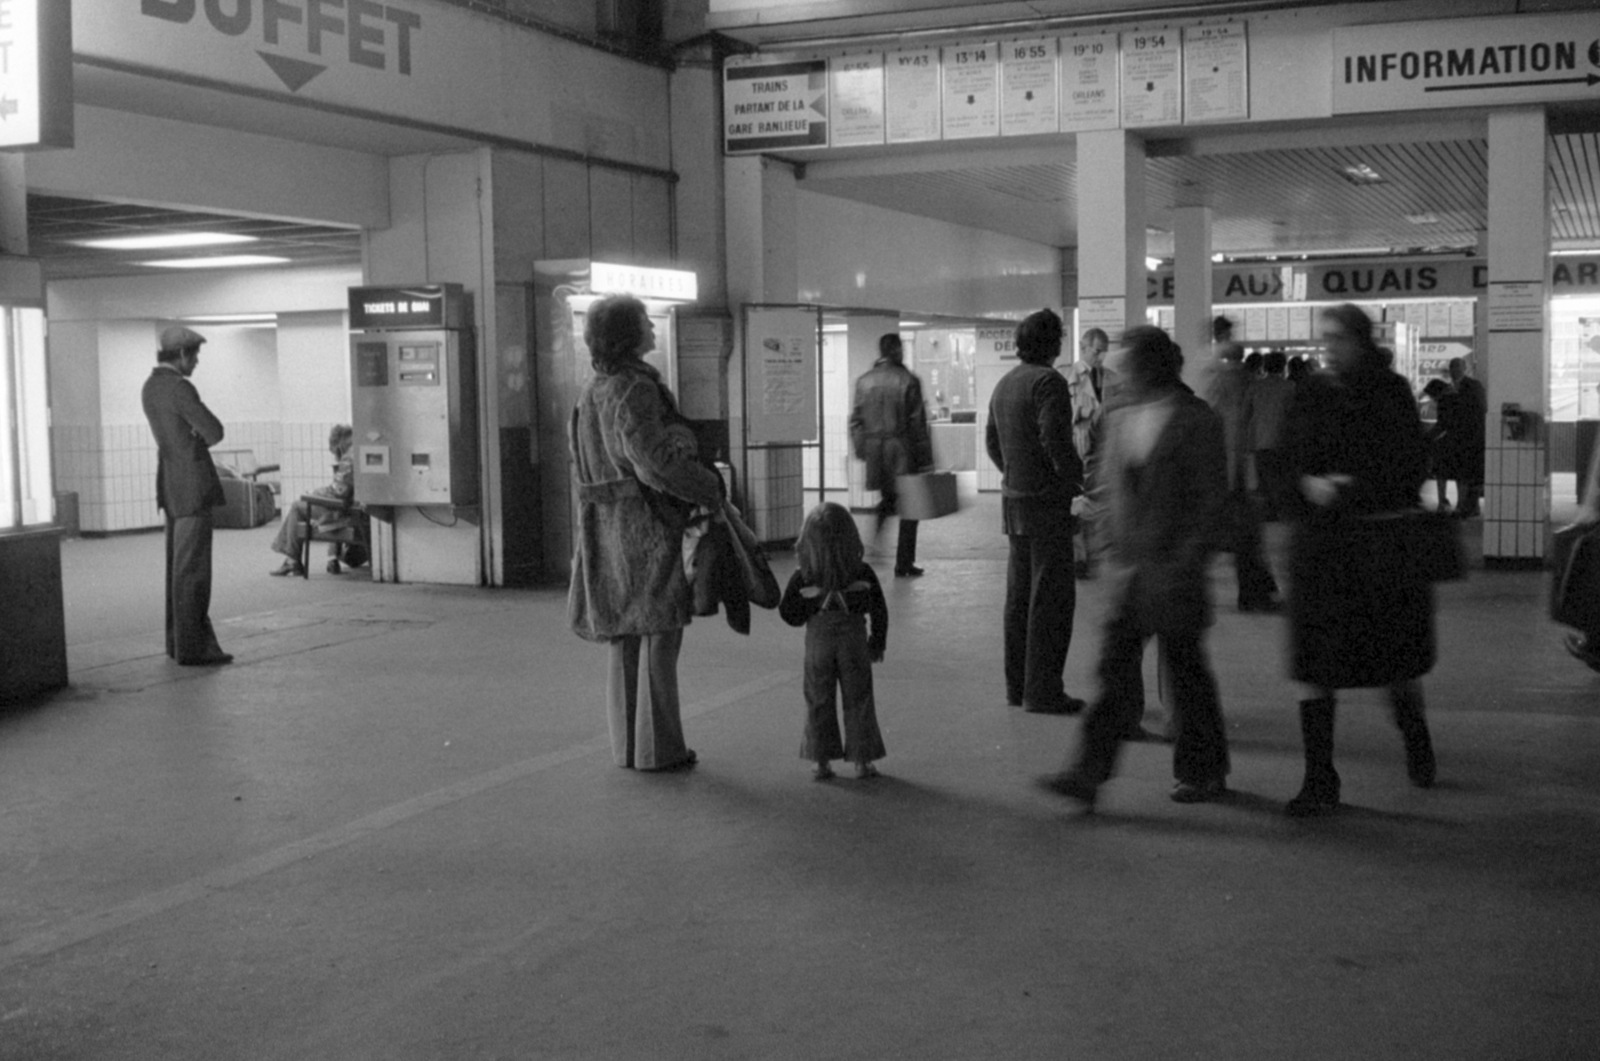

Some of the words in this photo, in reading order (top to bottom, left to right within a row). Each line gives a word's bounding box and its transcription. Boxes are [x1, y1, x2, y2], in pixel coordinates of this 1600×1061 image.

[1345, 41, 1576, 84] INFORMATION
[752, 80, 788, 94] TRAINS
[734, 102, 774, 115] PARTANT
[778, 101, 790, 112] DE
[793, 100, 804, 111] LA
[728, 123, 752, 135] GARE
[758, 119, 808, 133] BANLIEUE
[606, 272, 684, 292] HORAIRES
[1322, 266, 1437, 293] QUAIS
